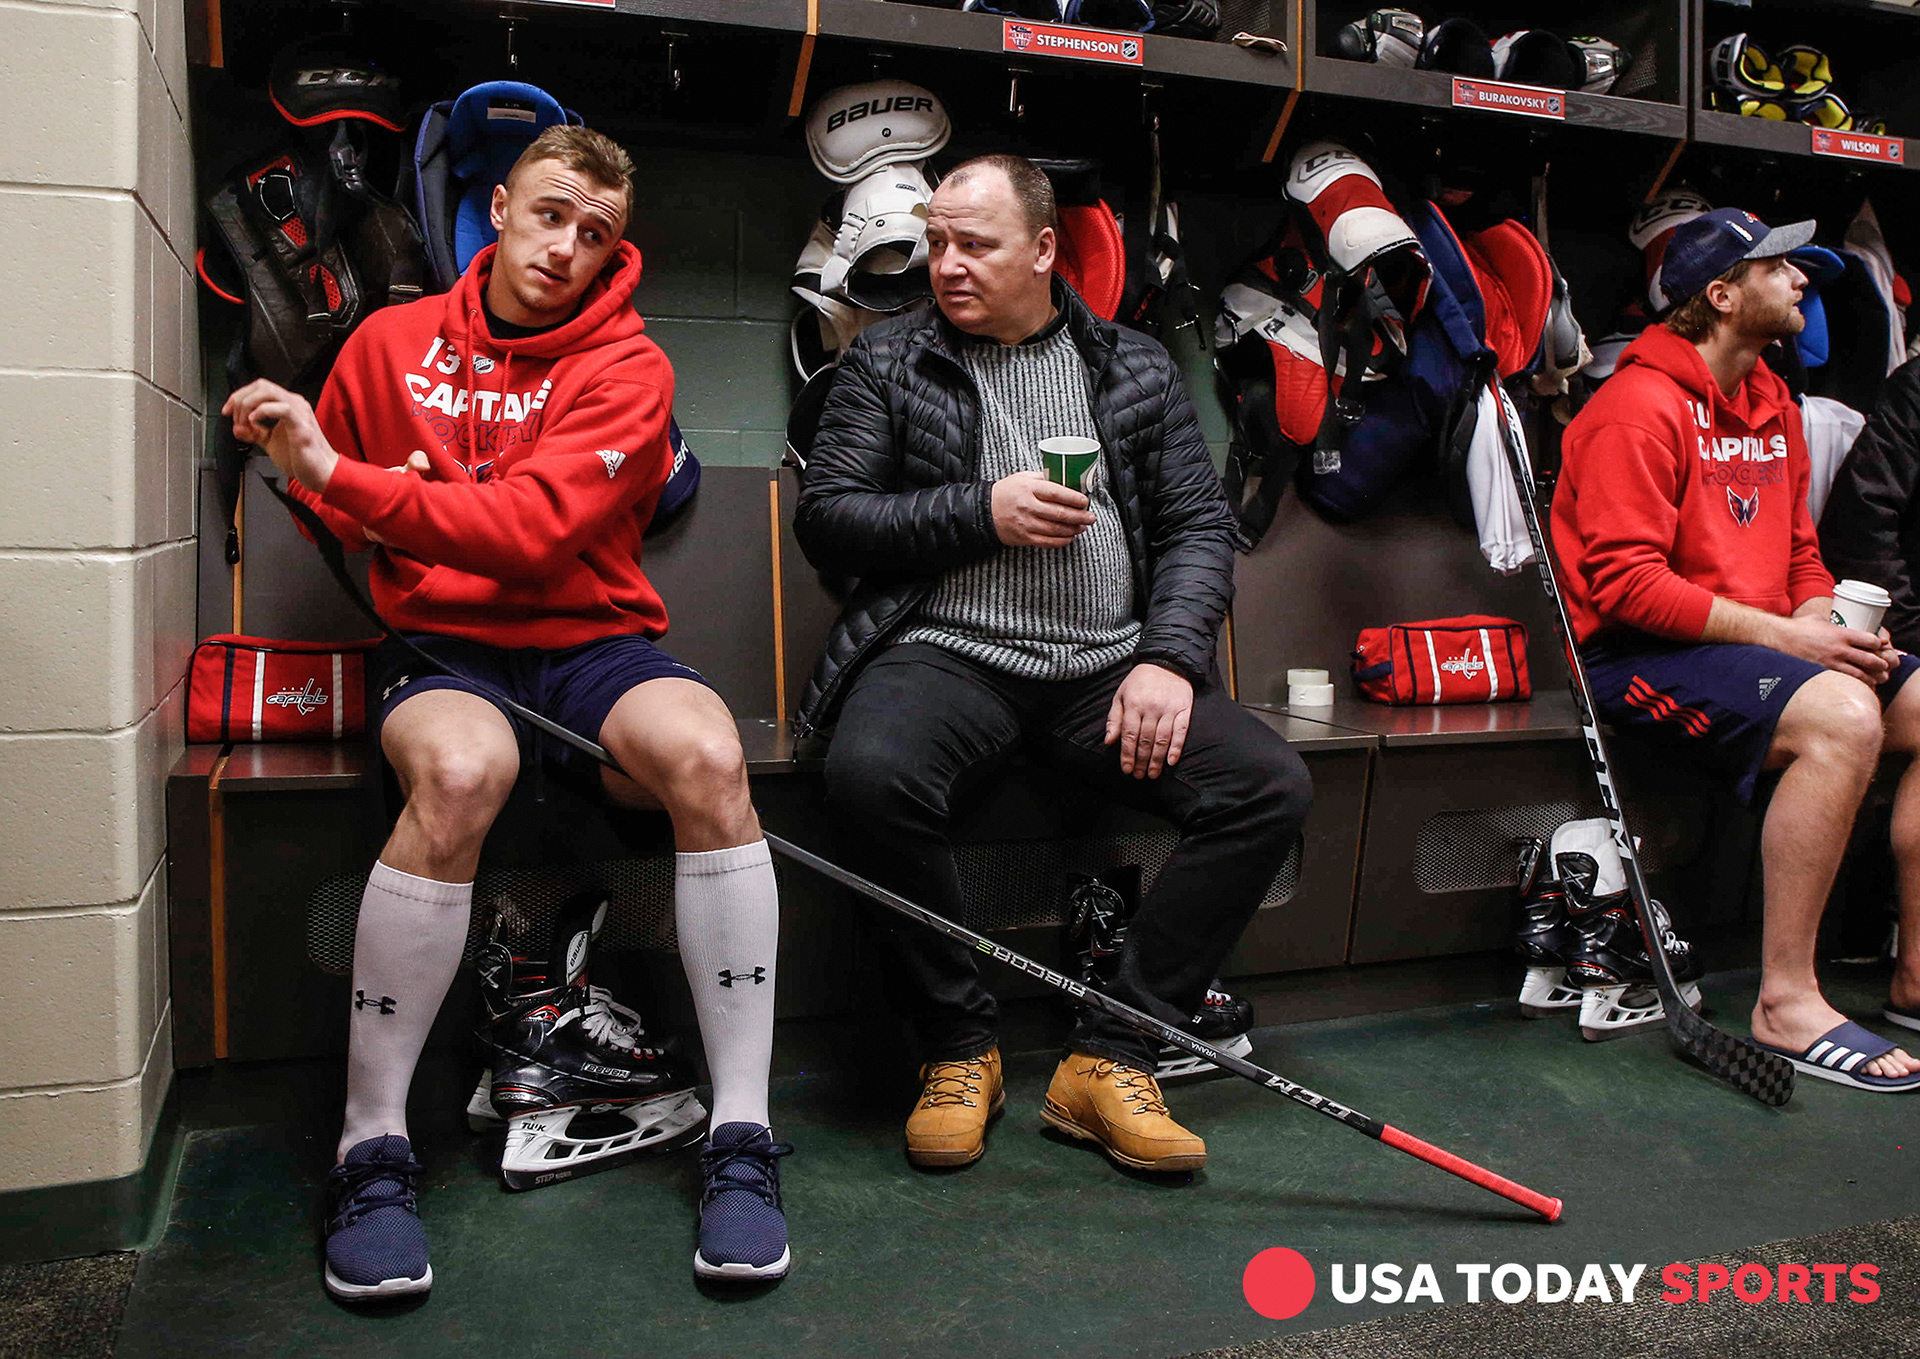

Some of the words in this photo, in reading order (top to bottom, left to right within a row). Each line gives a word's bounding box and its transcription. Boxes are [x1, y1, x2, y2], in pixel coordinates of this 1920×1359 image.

[1037, 34, 1119, 54] STEPHENSON
[1479, 91, 1546, 109] BURAKOVSKY
[1841, 140, 1880, 154] WILSON
[421, 337, 461, 375] 13
[266, 678, 328, 716] capitals
[1583, 725, 1633, 860] CCM
[1191, 1041, 1217, 1059] VRANA
[1264, 1074, 1352, 1121] CCM
